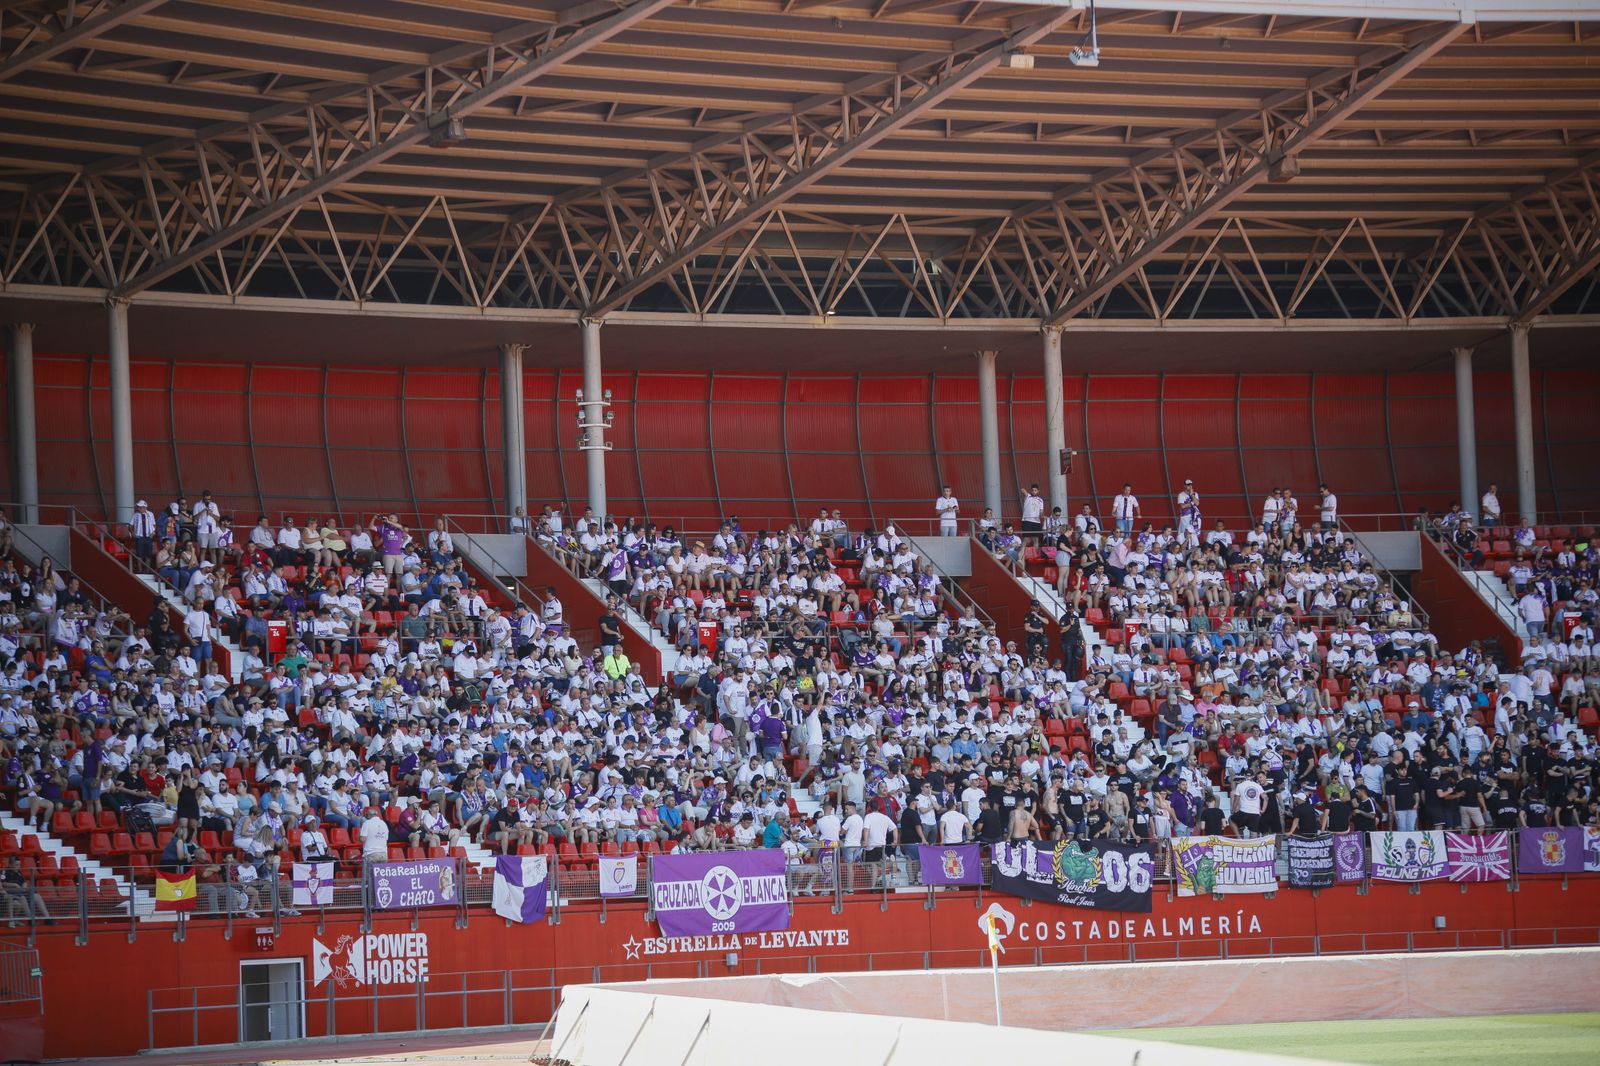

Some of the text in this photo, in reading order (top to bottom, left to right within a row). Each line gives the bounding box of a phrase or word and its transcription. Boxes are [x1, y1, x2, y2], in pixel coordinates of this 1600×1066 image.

[411, 877, 423, 890] EL
[1103, 850, 1150, 893] 06
[1376, 864, 1444, 880] YOUNG TNF
[400, 889, 435, 906] CHATO
[656, 876, 785, 908] CRUZADA BLANCA
[712, 922, 735, 932] 2009
[366, 933, 428, 959] POWER
[643, 929, 849, 955] ESTRELLA DE LEVANTE
[366, 958, 429, 985] HORSE
